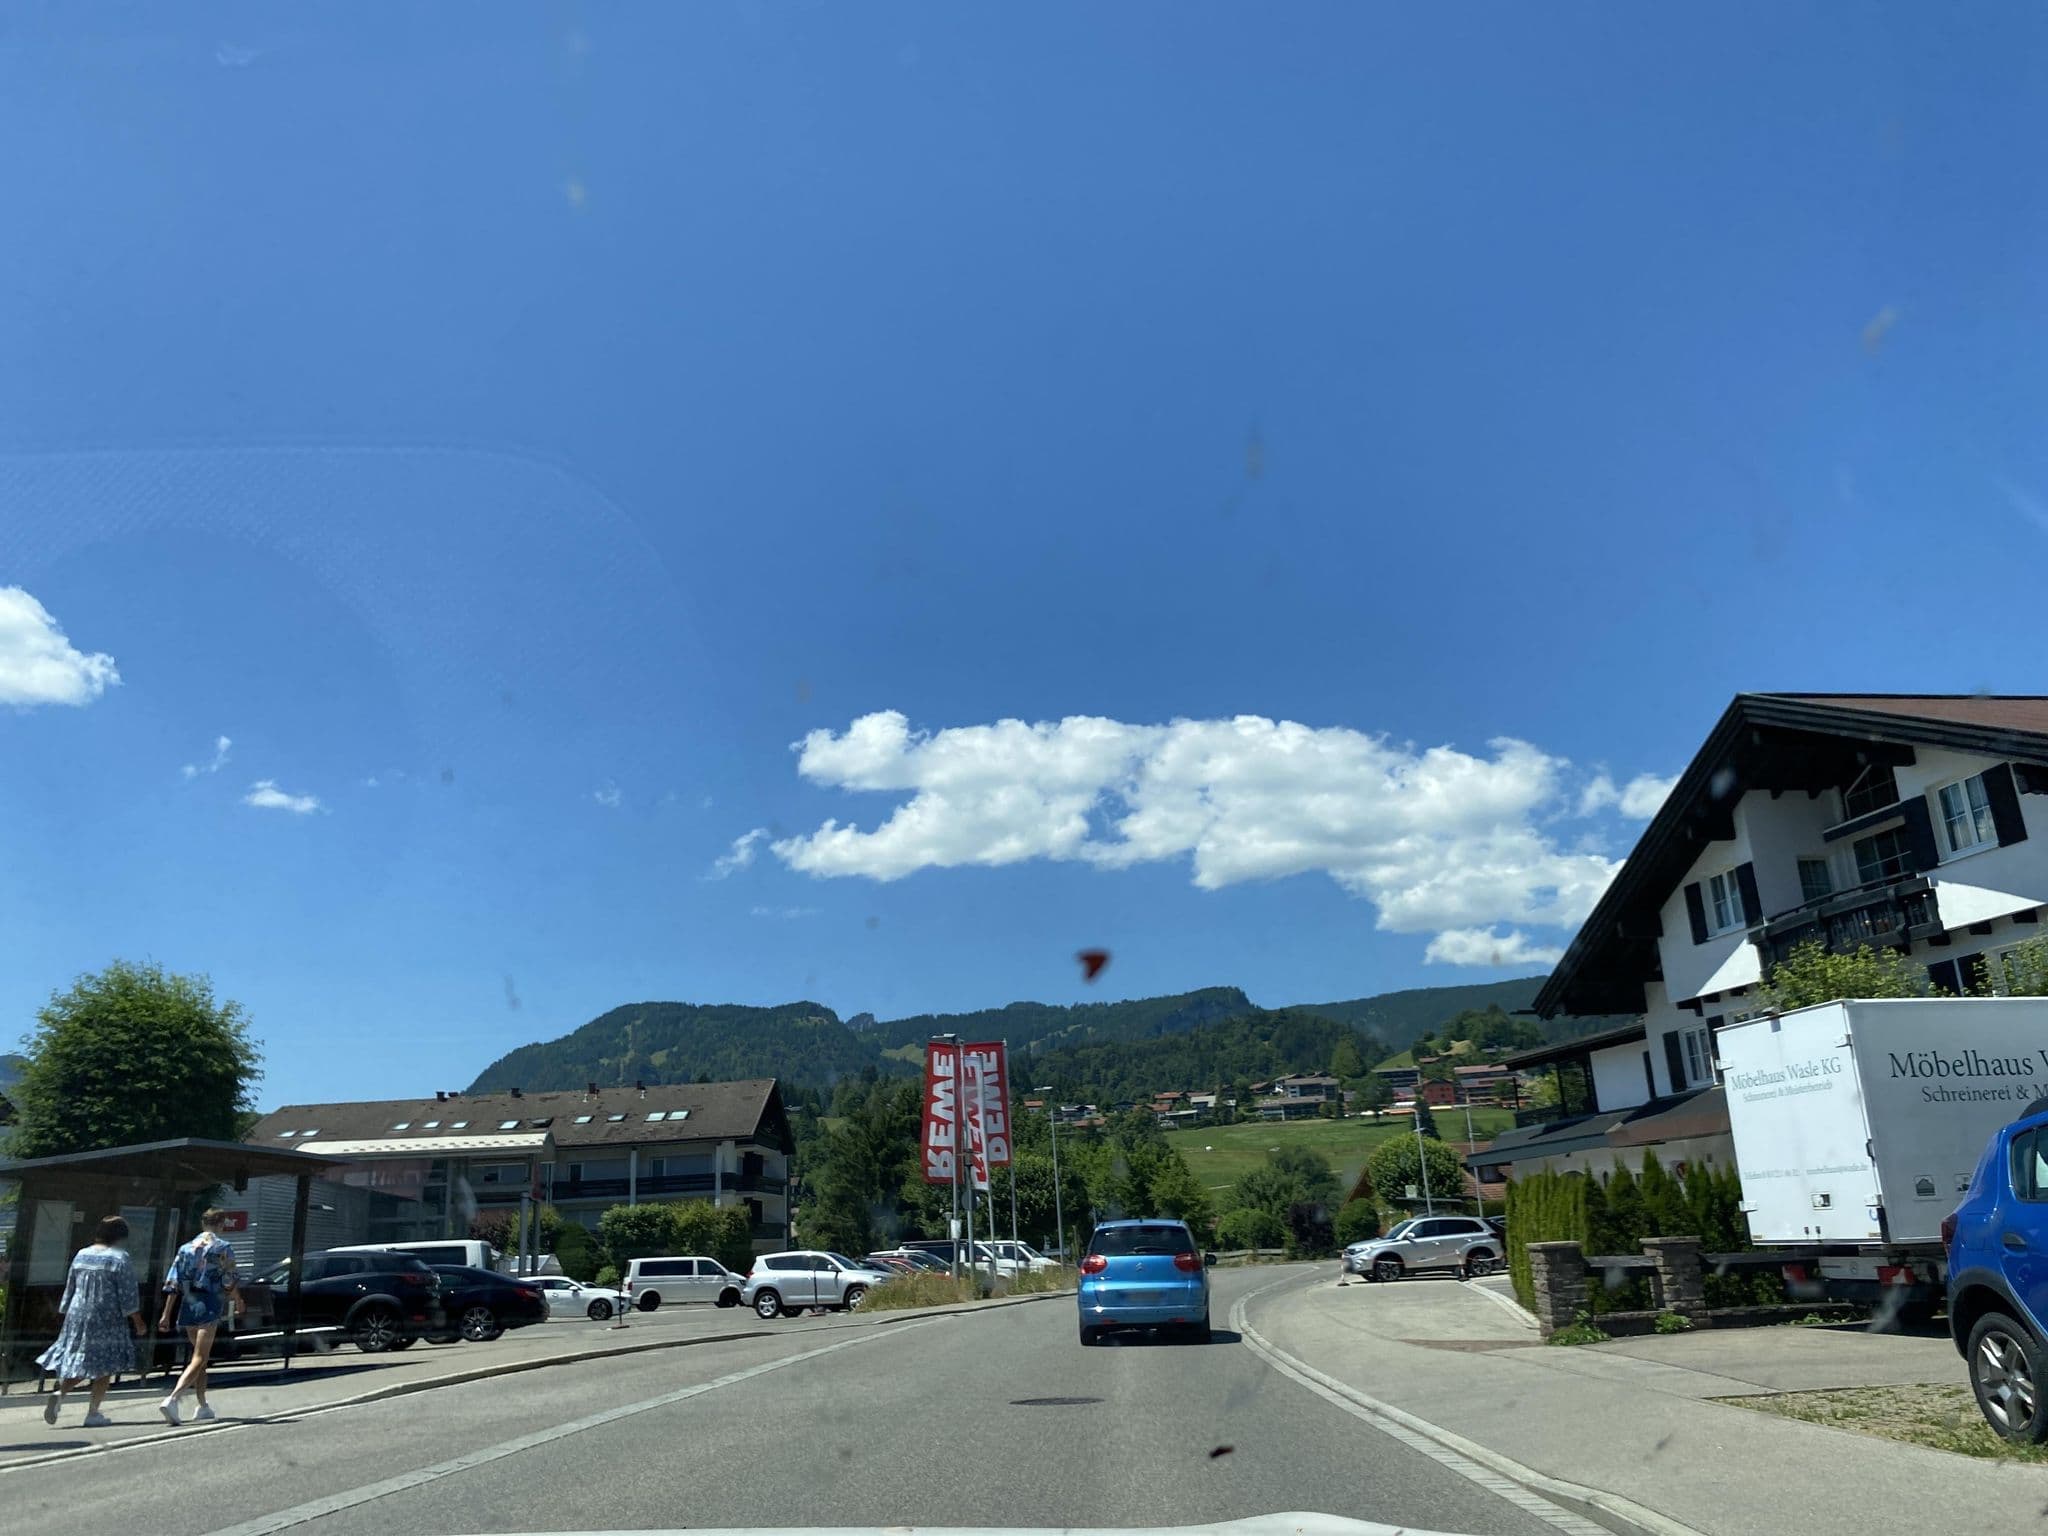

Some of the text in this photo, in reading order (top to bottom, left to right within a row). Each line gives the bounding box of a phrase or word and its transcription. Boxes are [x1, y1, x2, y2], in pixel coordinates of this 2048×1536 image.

[1820, 1056, 1842, 1075] KG
[1888, 1050, 2034, 1078] Möbelhaus
[1921, 1085, 2012, 1103] Schreinerei
[2016, 1084, 2030, 1100] &
